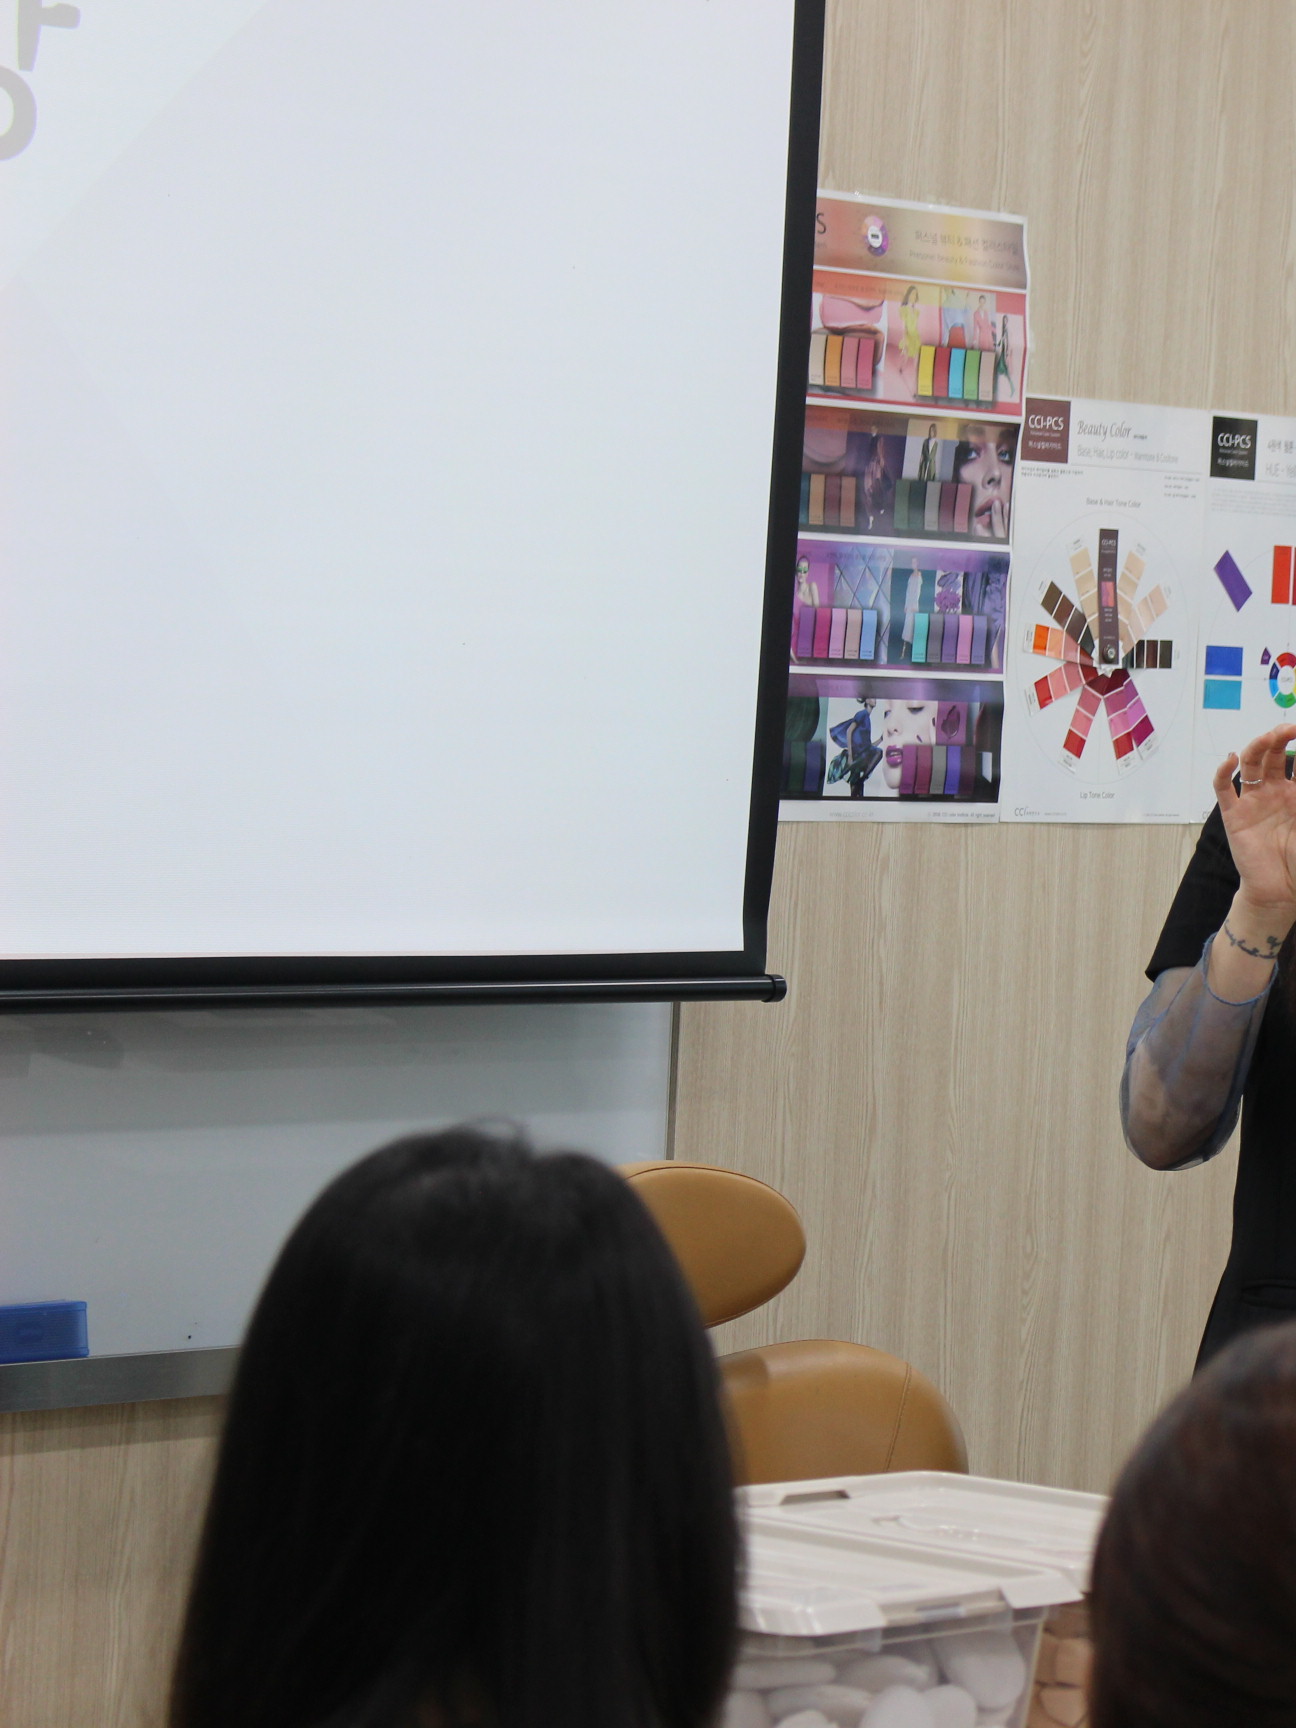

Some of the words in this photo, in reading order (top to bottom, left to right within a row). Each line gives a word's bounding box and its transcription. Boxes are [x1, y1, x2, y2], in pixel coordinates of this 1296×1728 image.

[1028, 414, 1064, 431] CCI-PCS
[1077, 420, 1108, 442] Beauty
[1109, 421, 1132, 438] Color
[1217, 432, 1251, 449] CCI-PCS
[1080, 791, 1088, 800] Lip
[1089, 791, 1101, 799] Tone
[1101, 791, 1115, 799] Color
